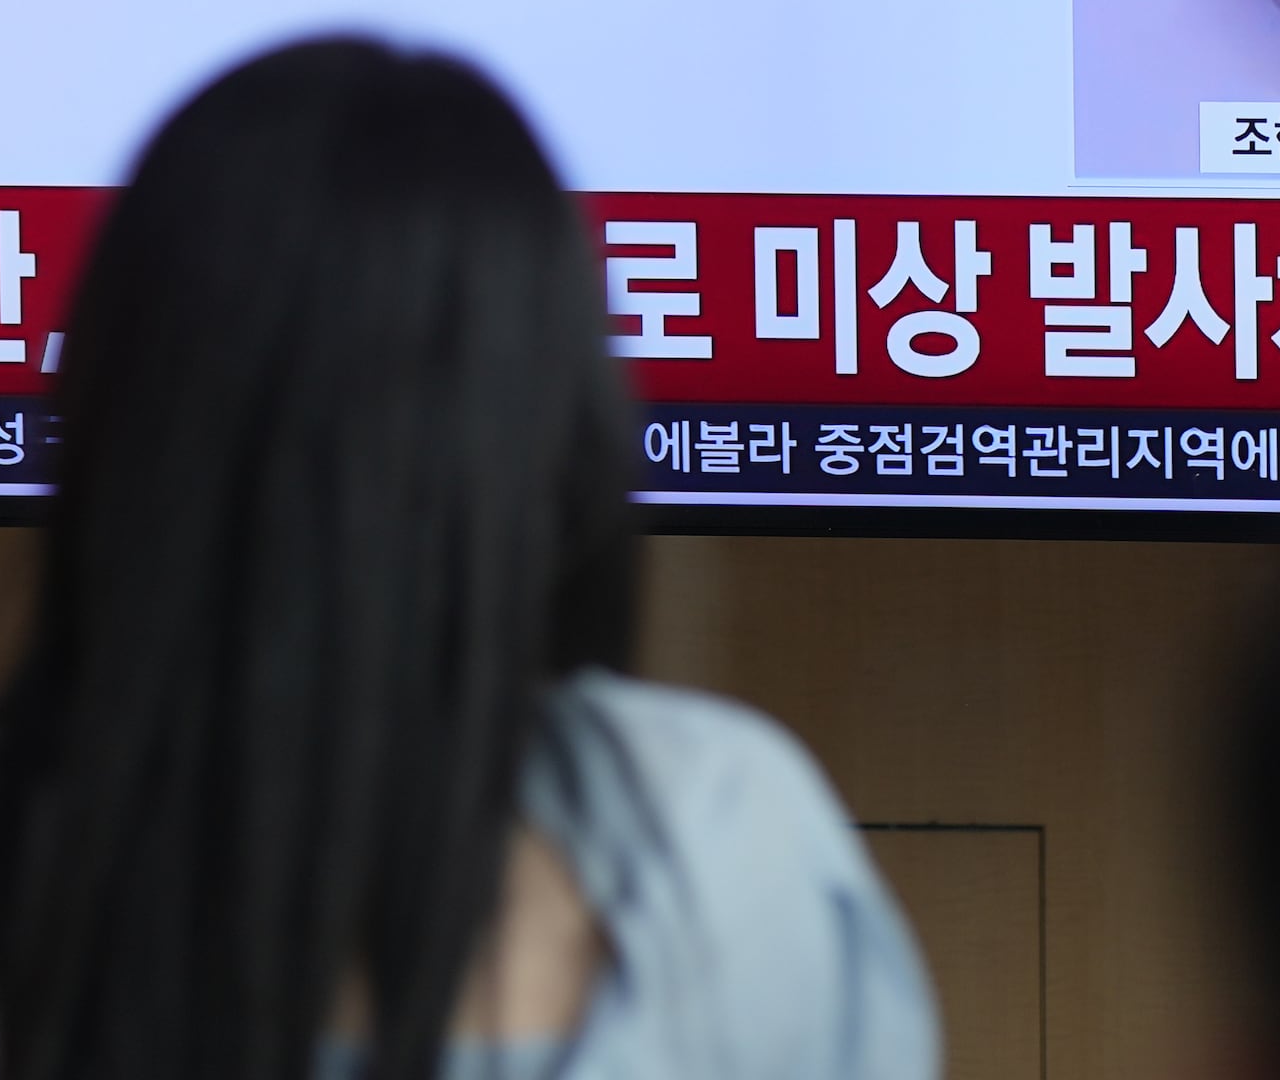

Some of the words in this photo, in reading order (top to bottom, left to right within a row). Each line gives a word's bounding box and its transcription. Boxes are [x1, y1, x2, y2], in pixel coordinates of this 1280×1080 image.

[753, 219, 993, 378] 미상
[642, 419, 798, 475] 에볼라
[813, 421, 1279, 482] 중점검역관리지역에
